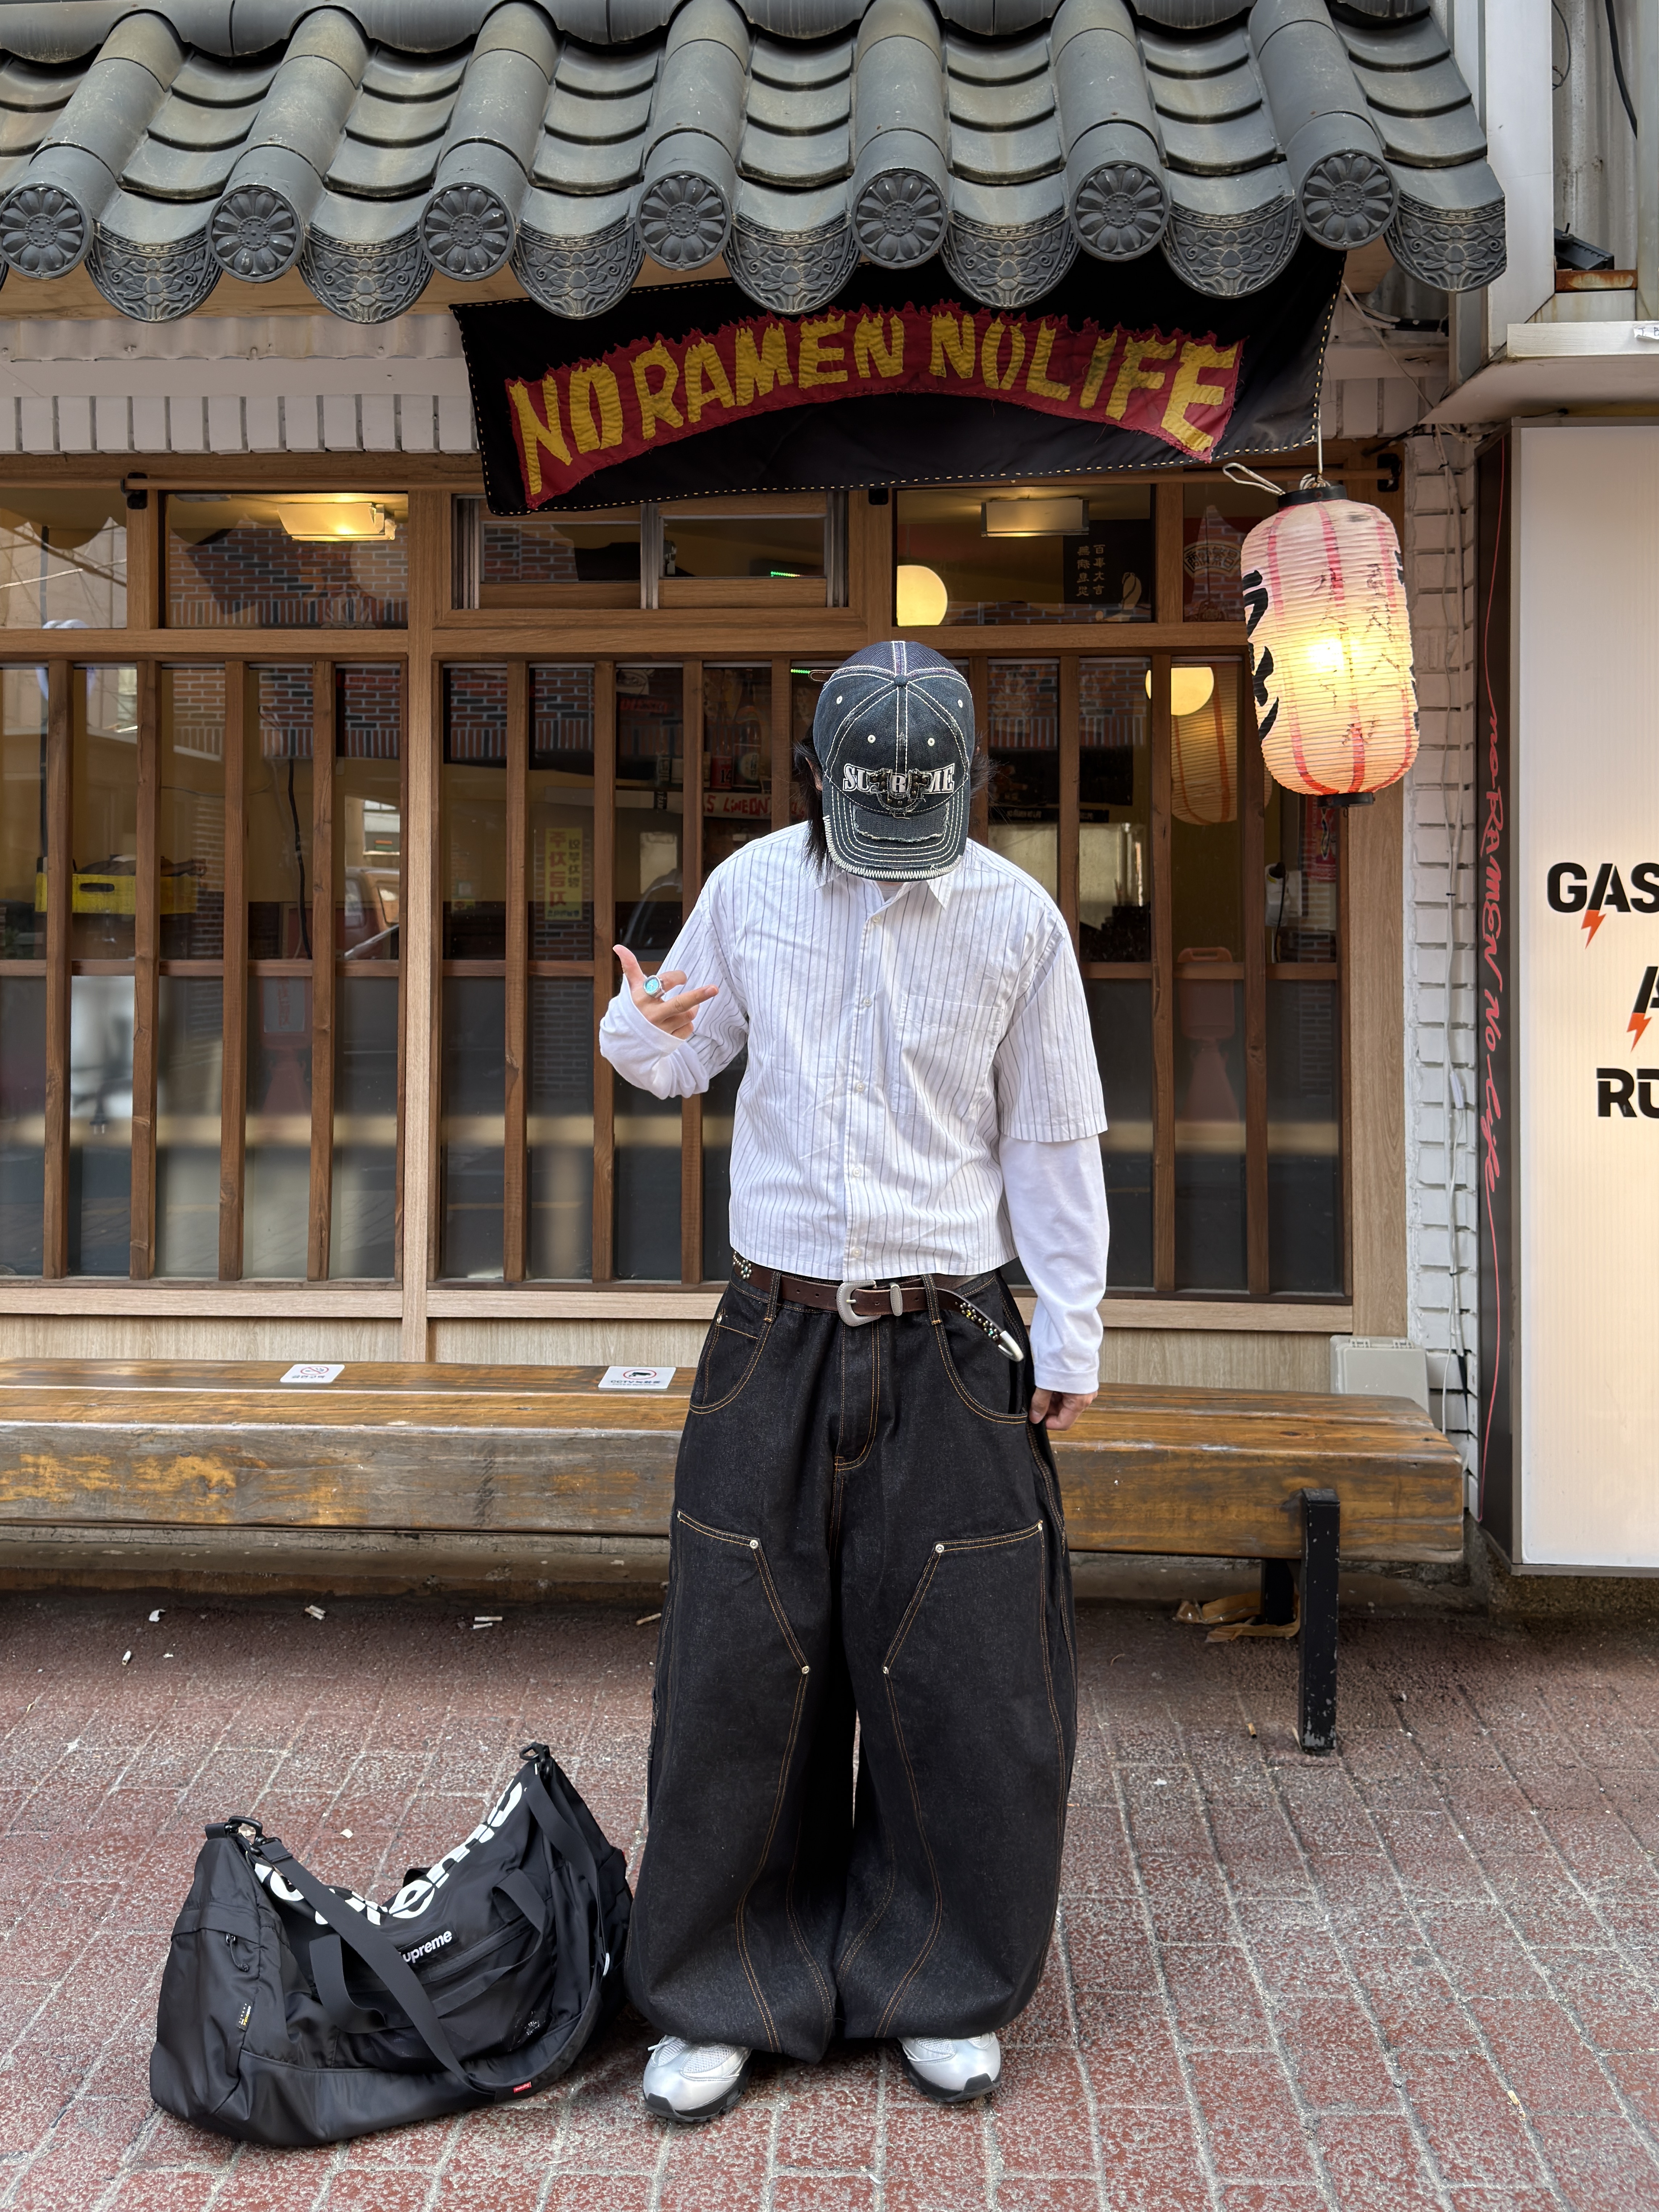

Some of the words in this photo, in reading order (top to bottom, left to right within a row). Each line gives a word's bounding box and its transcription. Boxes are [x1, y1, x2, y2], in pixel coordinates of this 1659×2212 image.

[510, 363, 623, 494] NO
[631, 315, 904, 440] RAMEN
[929, 312, 1025, 390] NO
[1025, 321, 1237, 451] LIFE
[1093, 544, 1106, 595] 百事大吉
[843, 763, 955, 795] SURME
[400, 1930, 452, 1963] upreme
